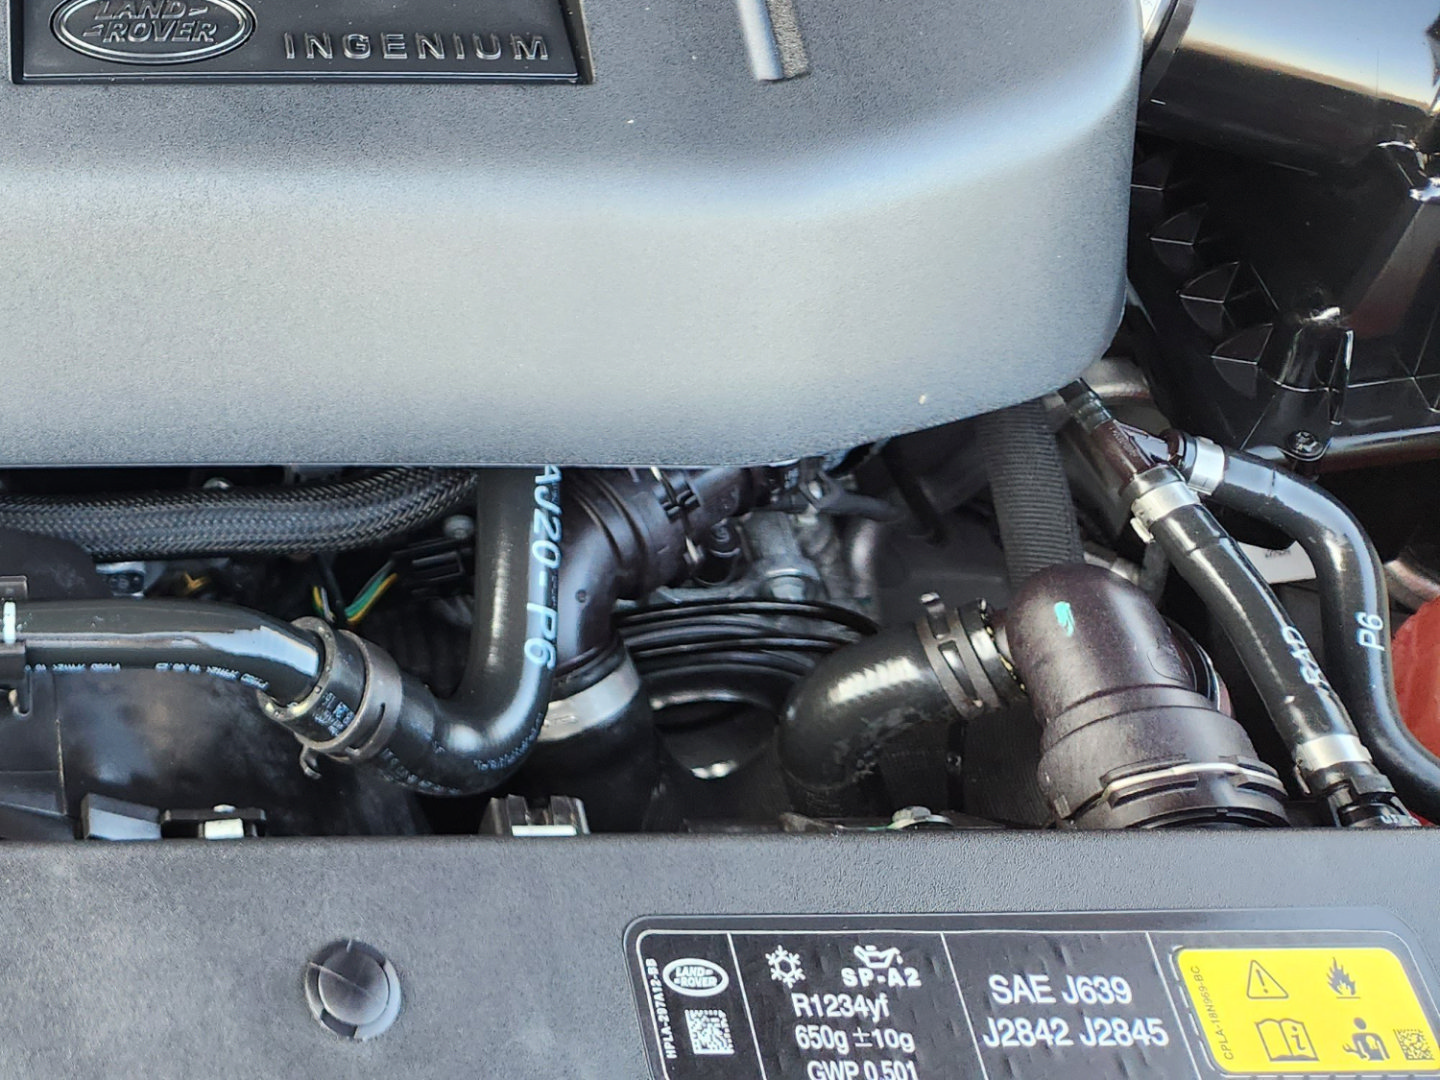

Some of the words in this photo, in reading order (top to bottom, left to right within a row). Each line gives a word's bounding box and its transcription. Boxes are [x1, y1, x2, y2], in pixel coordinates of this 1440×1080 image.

[94, 0, 187, 20] LAND
[102, 20, 218, 43] ROVER
[283, 31, 549, 61] INGENIUM
[1355, 611, 1385, 652] P6
[680, 976, 718, 987] ROVER
[841, 967, 922, 987] SP-A2
[988, 974, 1056, 1004] SAE
[1061, 974, 1133, 1004] J639
[791, 992, 890, 1023] R1234yf
[795, 1024, 850, 1055] 650g
[982, 1017, 1074, 1047] J2842
[1079, 1016, 1170, 1047] J2845
[807, 1060, 860, 1080] GWP
[863, 1060, 919, 1080] 0.501
